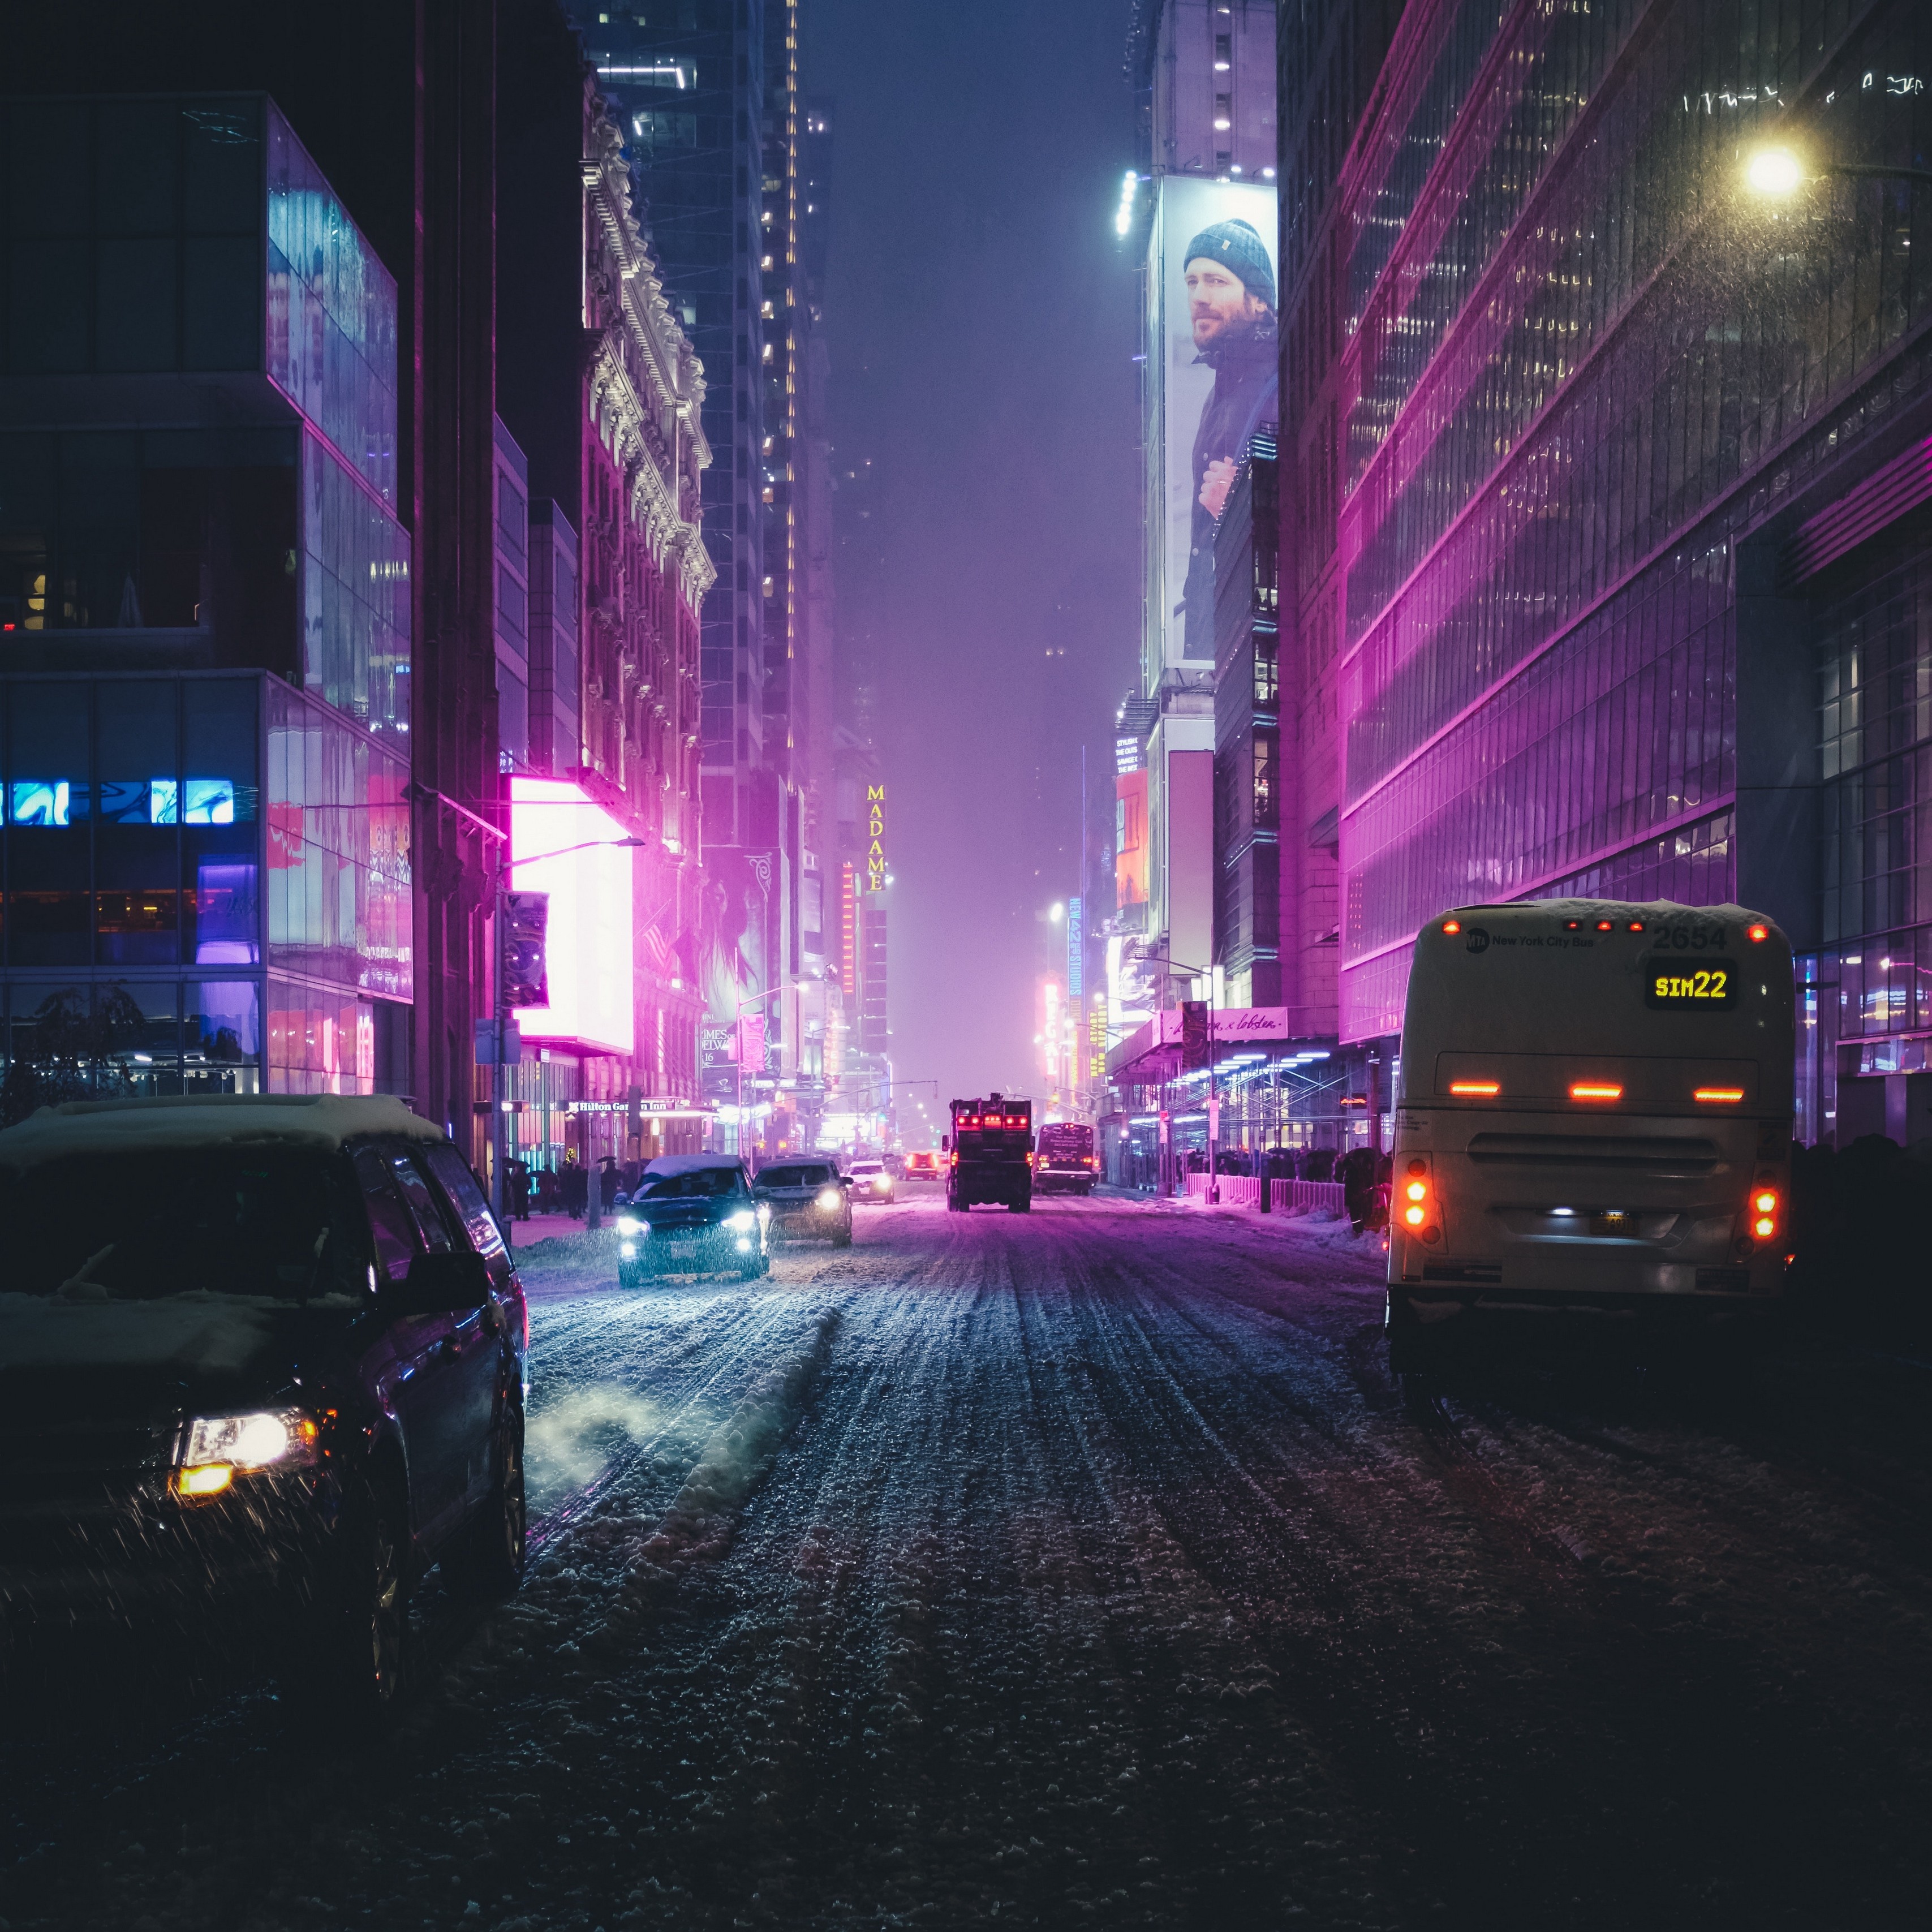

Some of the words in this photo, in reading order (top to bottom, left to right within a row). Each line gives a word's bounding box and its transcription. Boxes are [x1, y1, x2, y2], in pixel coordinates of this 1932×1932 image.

[867, 785, 885, 890] MADAME
[1070, 898, 1081, 919] NEW
[1467, 933, 1486, 948] MTA
[1492, 936, 1517, 945] New
[1519, 936, 1544, 946] York
[1547, 936, 1569, 948] City
[1573, 937, 1594, 947] Bus
[1653, 926, 1727, 950] 2654
[1070, 956, 1081, 995] STUDIOS
[1656, 971, 1727, 997] SIM22
[702, 1029, 727, 1039] IMES
[705, 1053, 713, 1061] 16
[580, 1103, 612, 1111] Hilton
[613, 1102, 647, 1111] Garn
